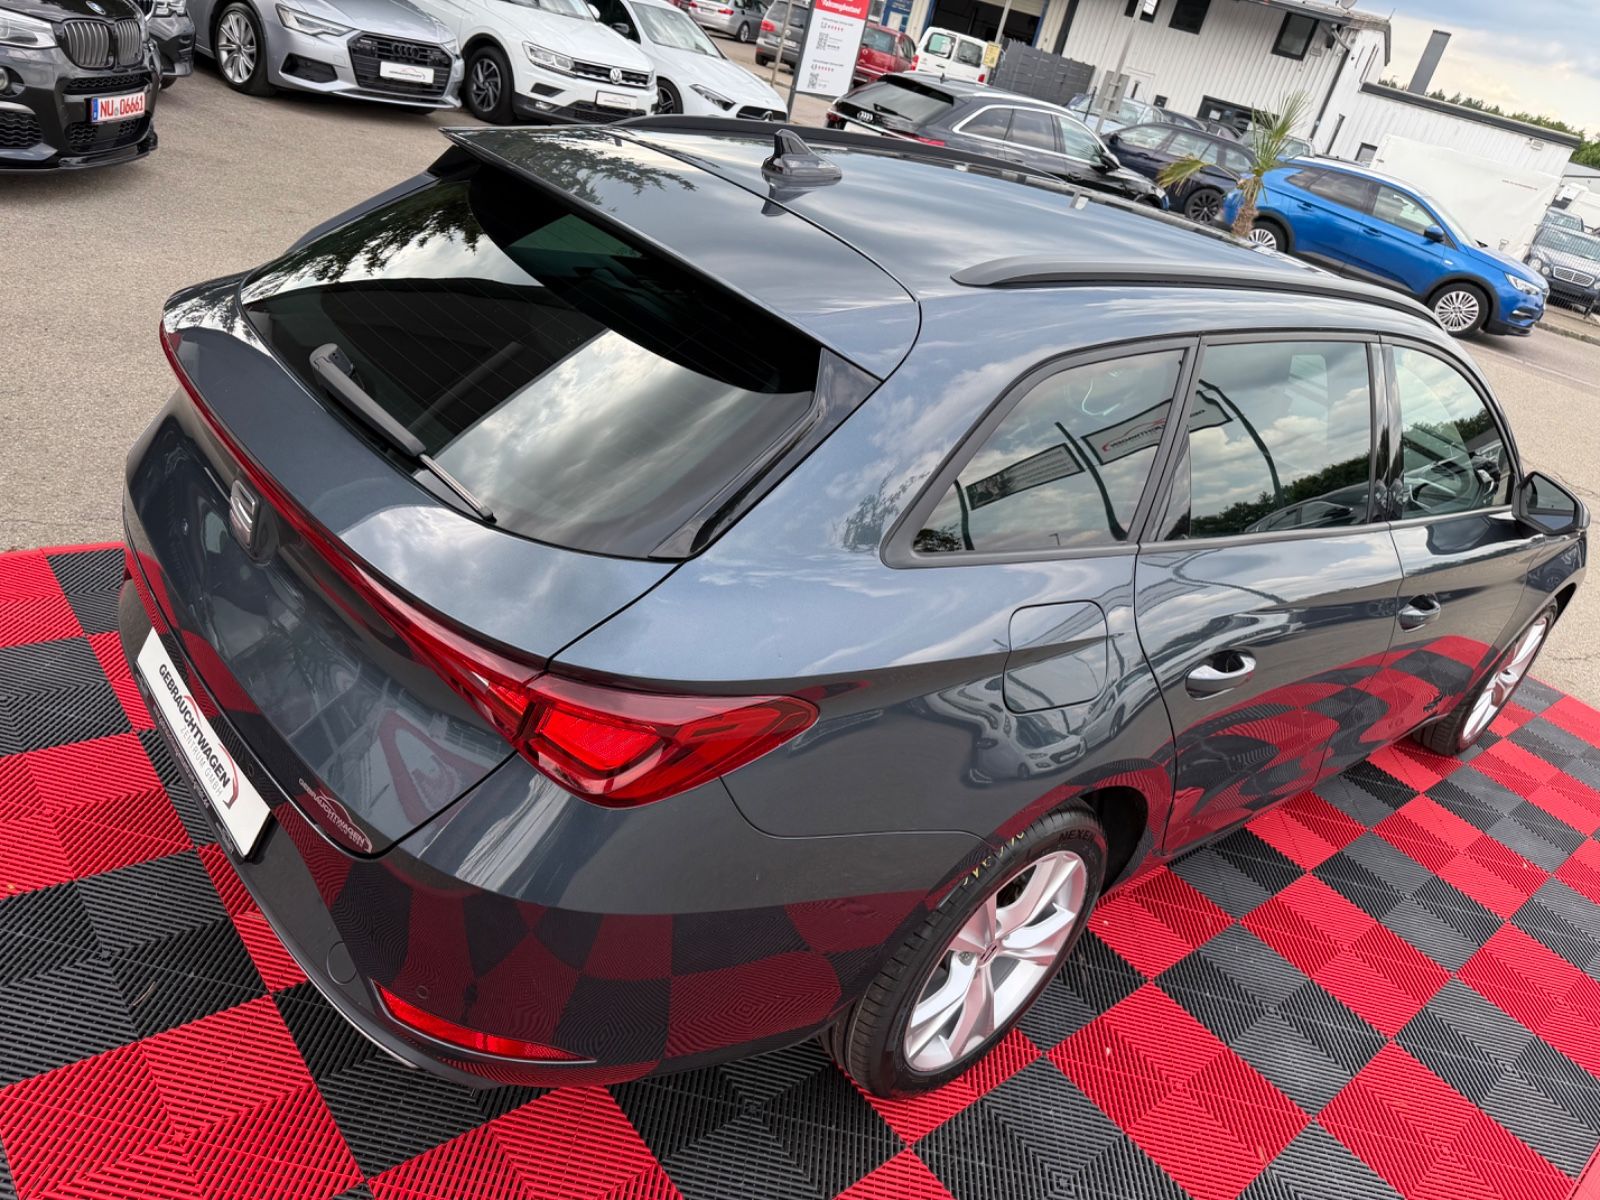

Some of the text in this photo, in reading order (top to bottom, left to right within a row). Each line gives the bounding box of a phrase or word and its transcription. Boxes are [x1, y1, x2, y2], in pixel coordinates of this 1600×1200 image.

[100, 100, 114, 117] NU
[159, 664, 231, 788] GEBRAUCHTWAGEN
[180, 726, 223, 796] ZENTRUM GMBH
